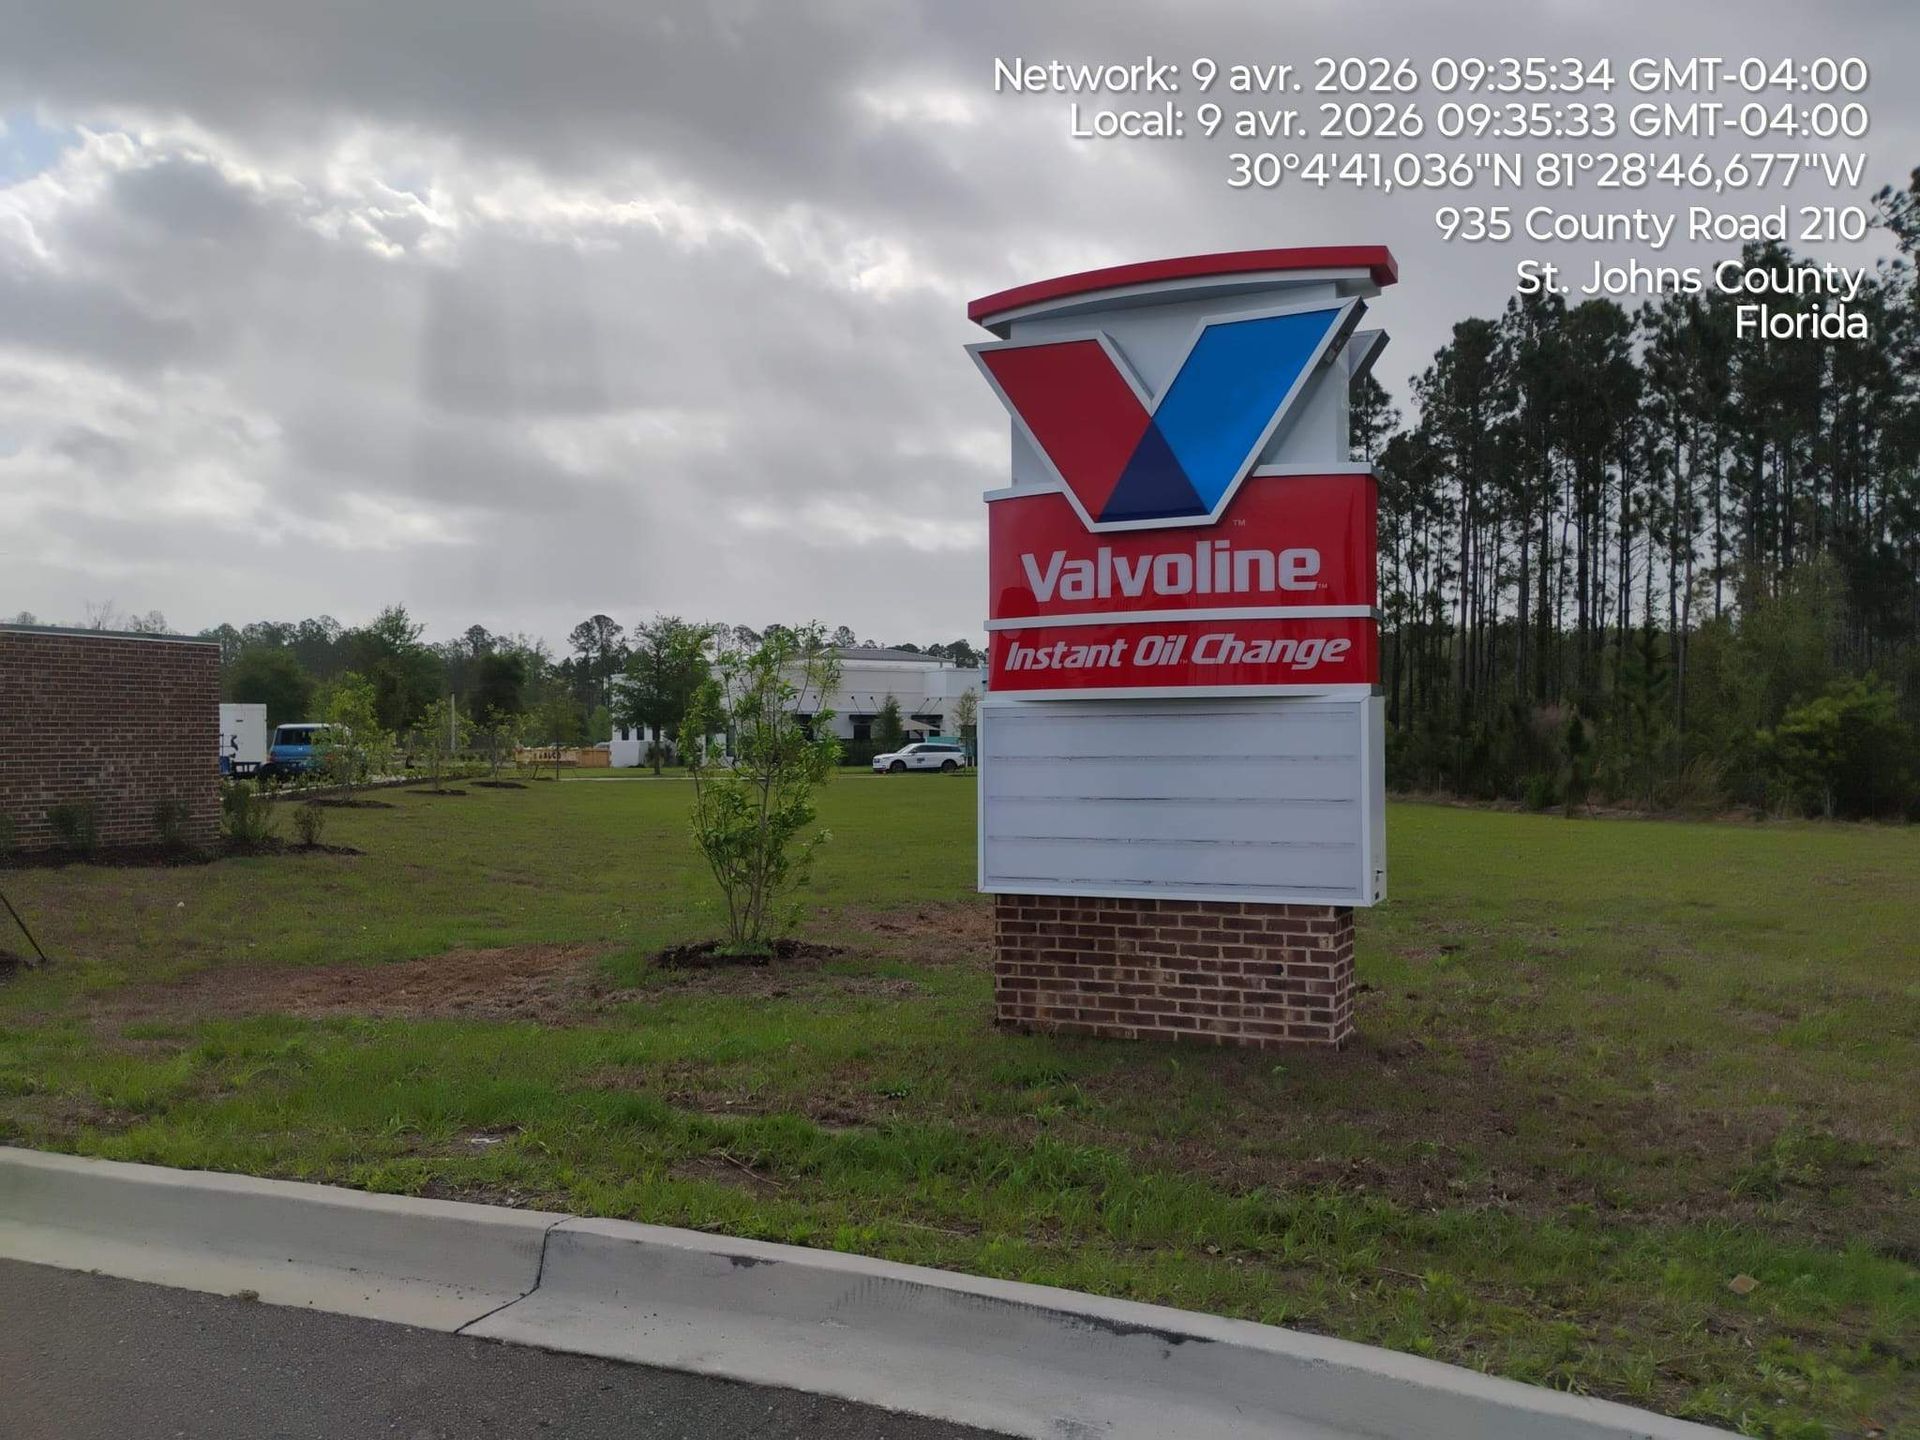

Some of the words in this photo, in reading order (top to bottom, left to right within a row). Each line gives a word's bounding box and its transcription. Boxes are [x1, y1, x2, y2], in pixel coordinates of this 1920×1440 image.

[1021, 540, 1321, 603] Valvoline
[1005, 638, 1128, 671] Instant
[1133, 634, 1188, 667] Oil
[1191, 632, 1351, 670] Change
